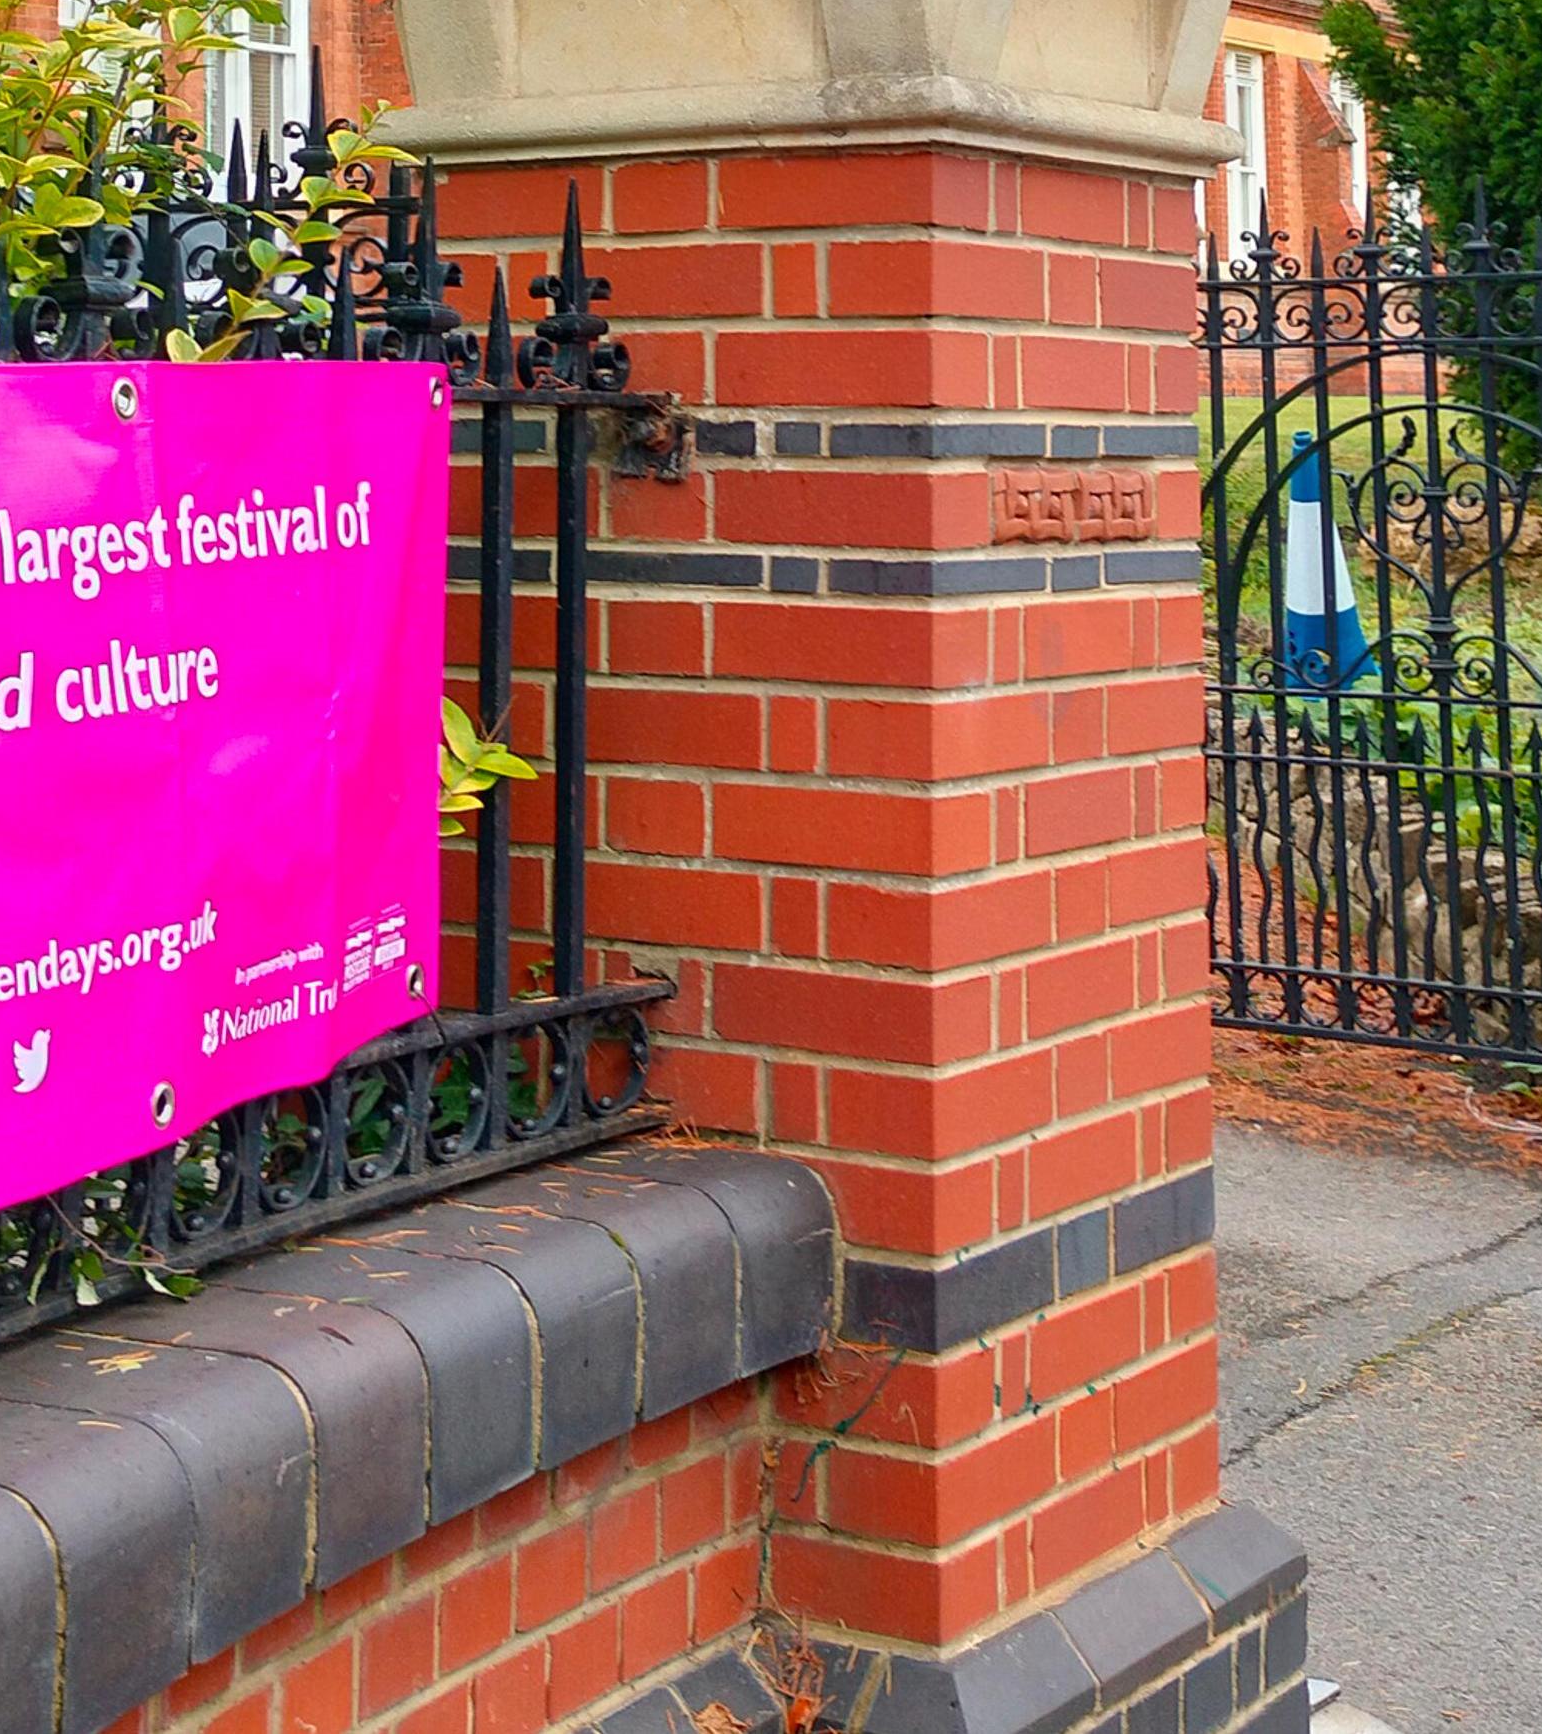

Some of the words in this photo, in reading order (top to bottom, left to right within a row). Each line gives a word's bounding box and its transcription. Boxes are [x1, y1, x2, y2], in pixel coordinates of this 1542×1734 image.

[176, 490, 327, 565] festival
[336, 481, 371, 549] of
[55, 639, 219, 723] culture
[221, 985, 300, 1045] National
[303, 979, 338, 1016] Tru
